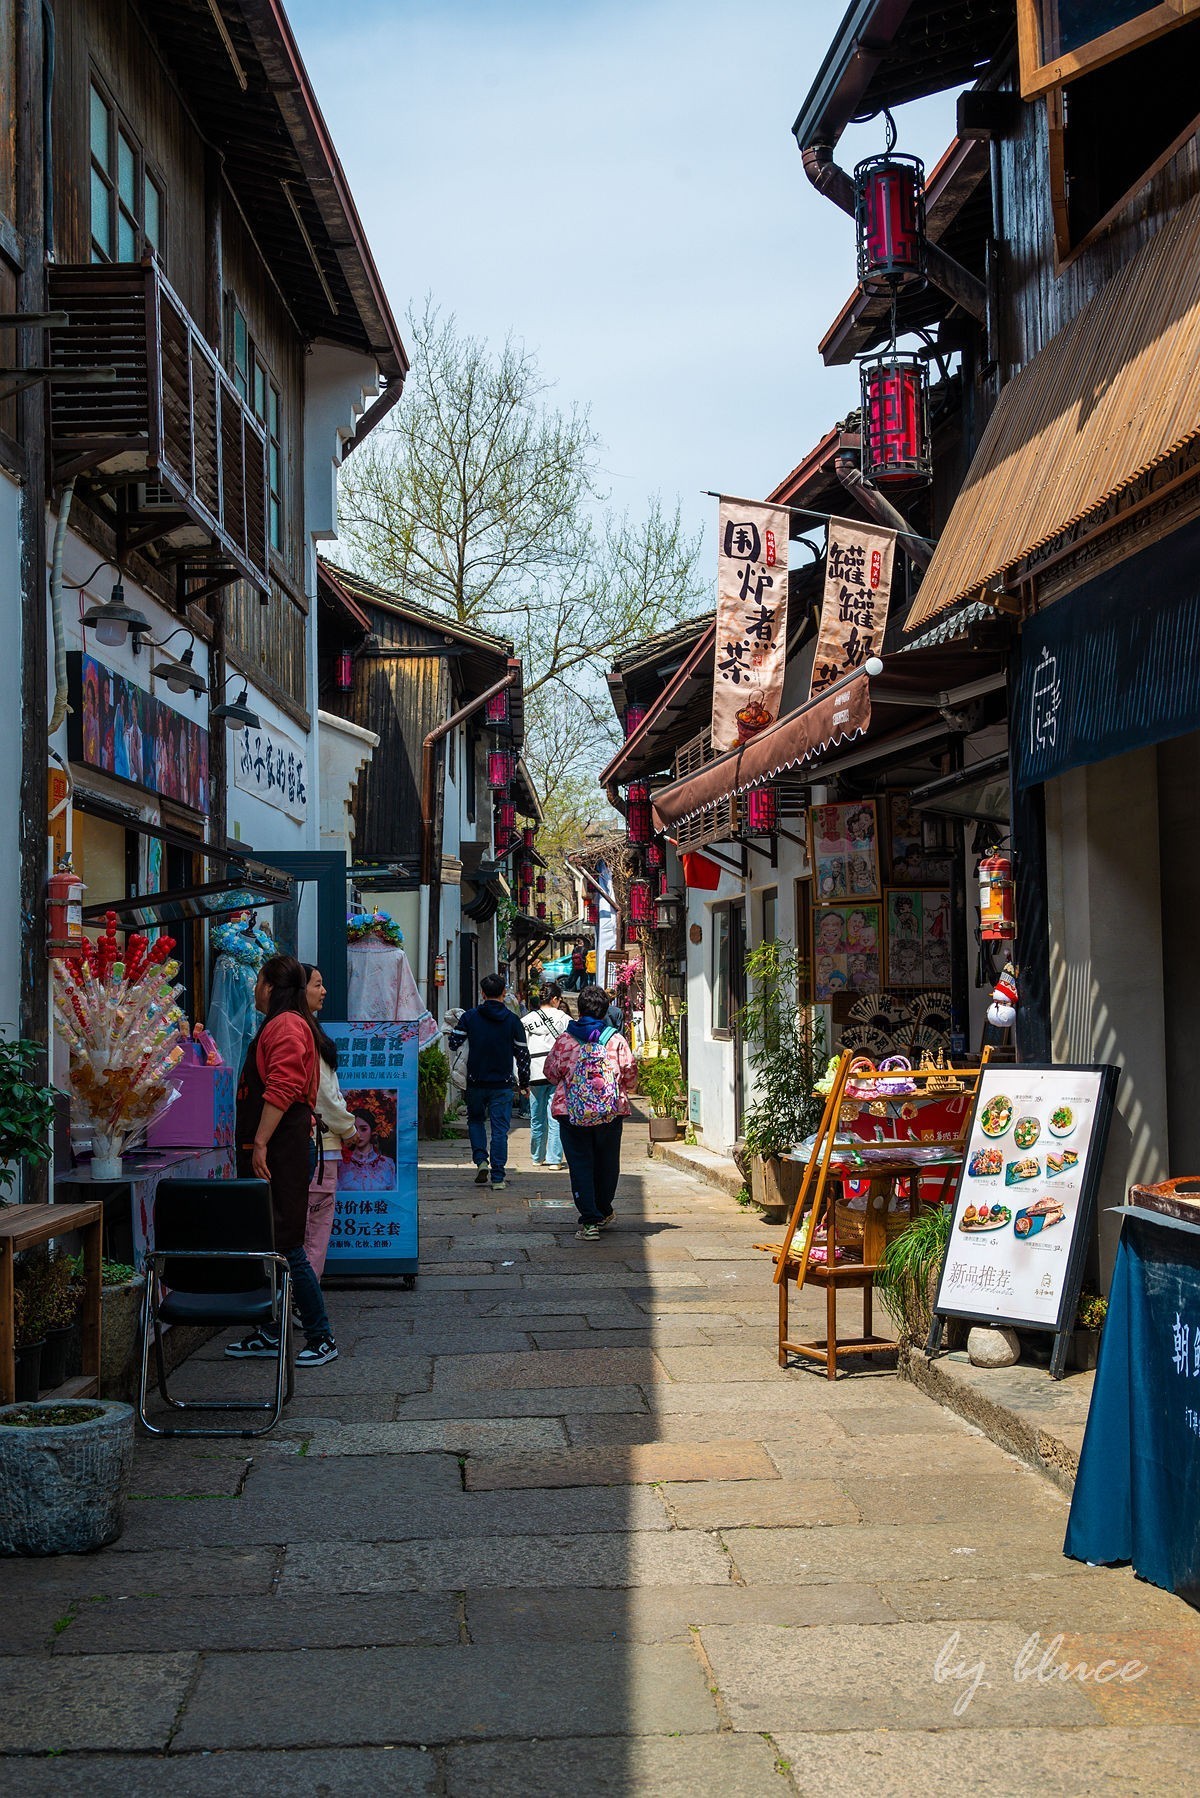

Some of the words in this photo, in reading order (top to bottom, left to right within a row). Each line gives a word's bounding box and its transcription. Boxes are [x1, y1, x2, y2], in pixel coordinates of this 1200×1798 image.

[718, 520, 776, 684] 围炉煮茶
[335, 1200, 388, 1214] 特价体验
[947, 1261, 1012, 1287] 新品推荐
